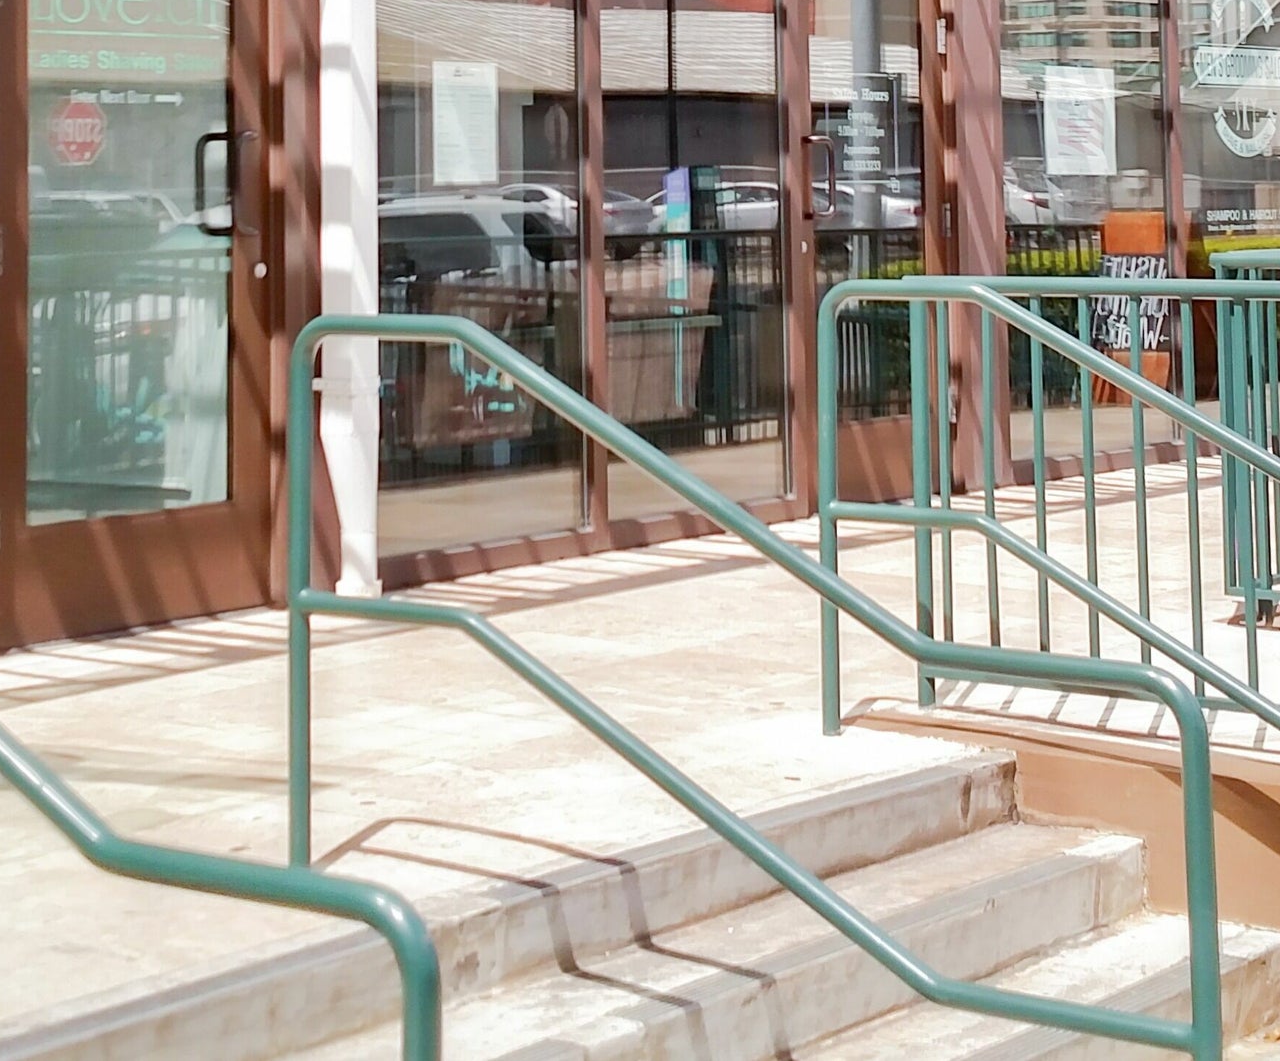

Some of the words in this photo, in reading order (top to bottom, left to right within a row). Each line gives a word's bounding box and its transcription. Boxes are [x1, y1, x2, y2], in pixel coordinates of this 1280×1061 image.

[97, 49, 167, 74] Shaving
[861, 88, 890, 102] Hours
[1206, 209, 1241, 222] SHAMPOO
